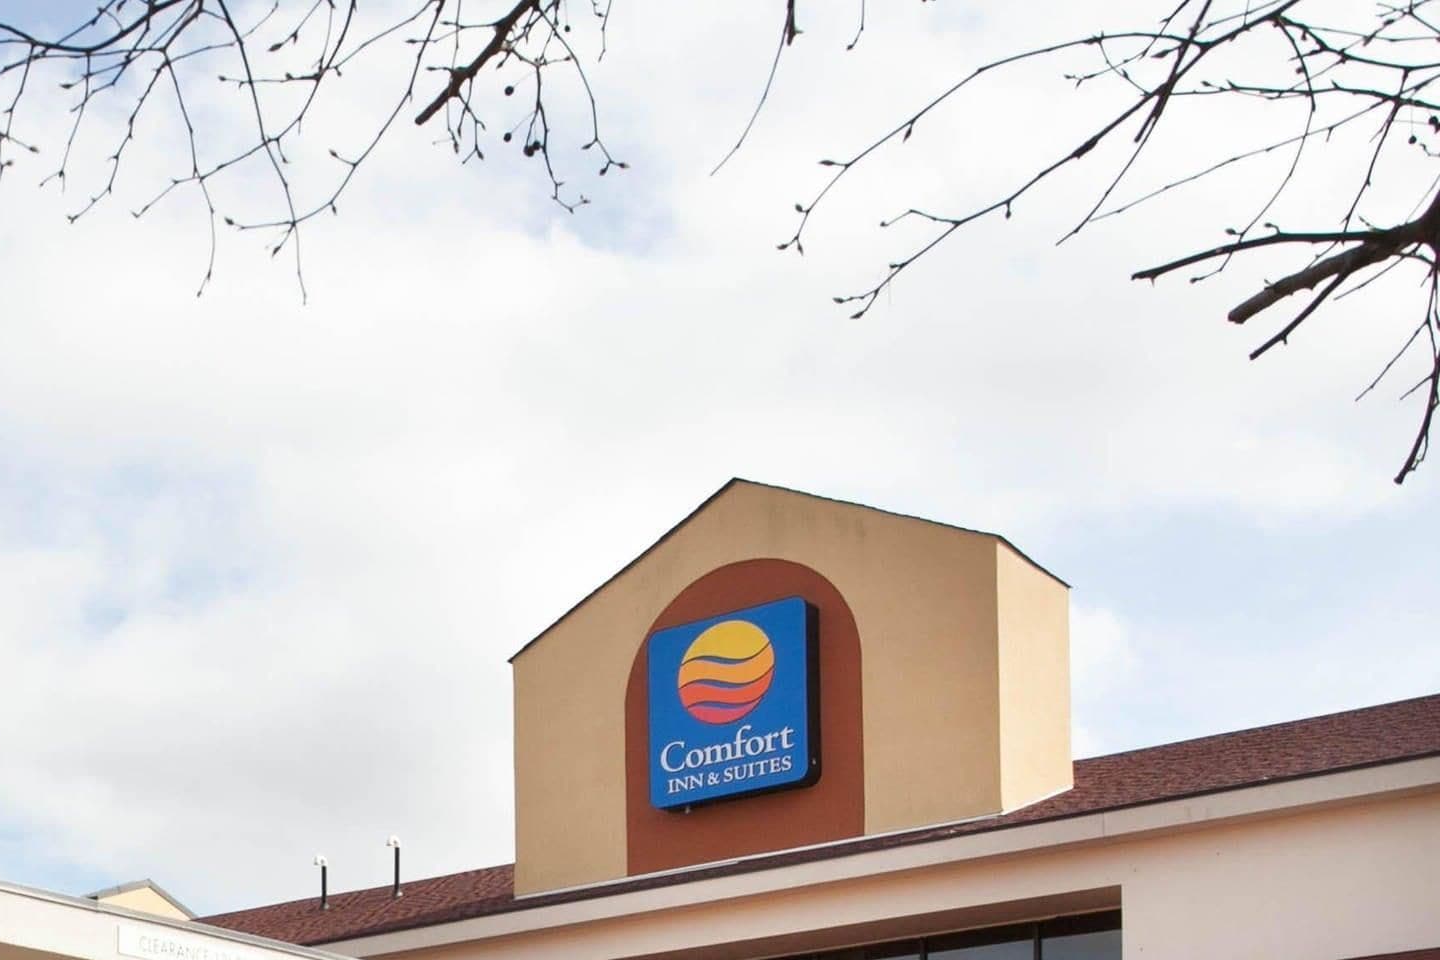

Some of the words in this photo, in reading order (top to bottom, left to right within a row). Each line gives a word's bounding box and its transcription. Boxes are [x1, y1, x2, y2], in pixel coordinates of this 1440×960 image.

[660, 725, 795, 773] Comfort
[667, 771, 704, 794] INN
[707, 771, 720, 786] &
[723, 755, 793, 783] SUITES
